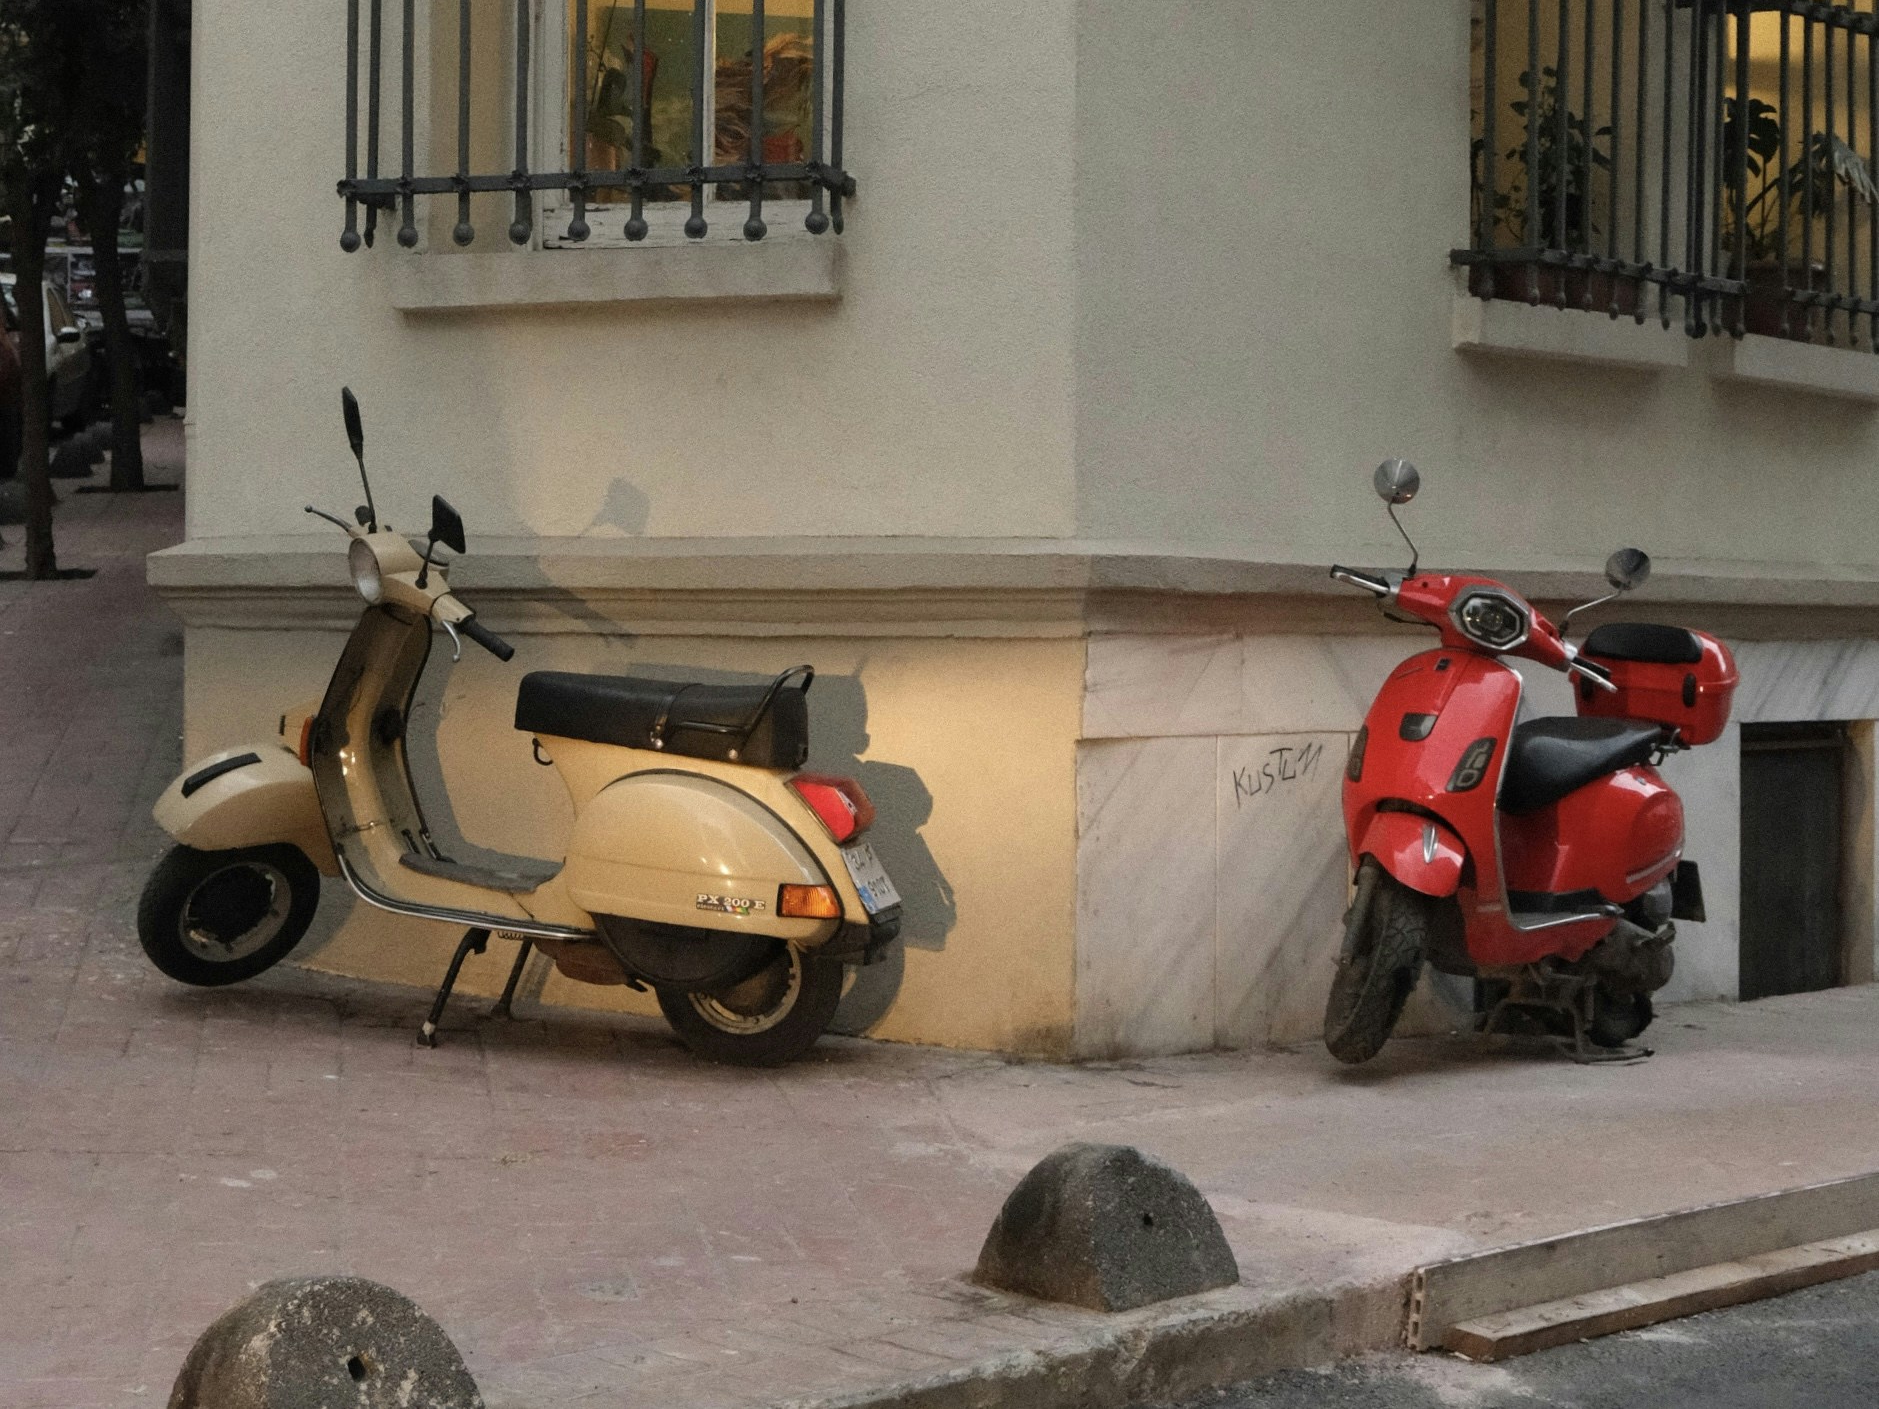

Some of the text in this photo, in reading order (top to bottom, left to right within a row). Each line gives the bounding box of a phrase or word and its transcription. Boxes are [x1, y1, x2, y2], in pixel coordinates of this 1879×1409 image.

[697, 893, 719, 905] PX
[723, 897, 750, 907] 200
[754, 900, 765, 910] E
